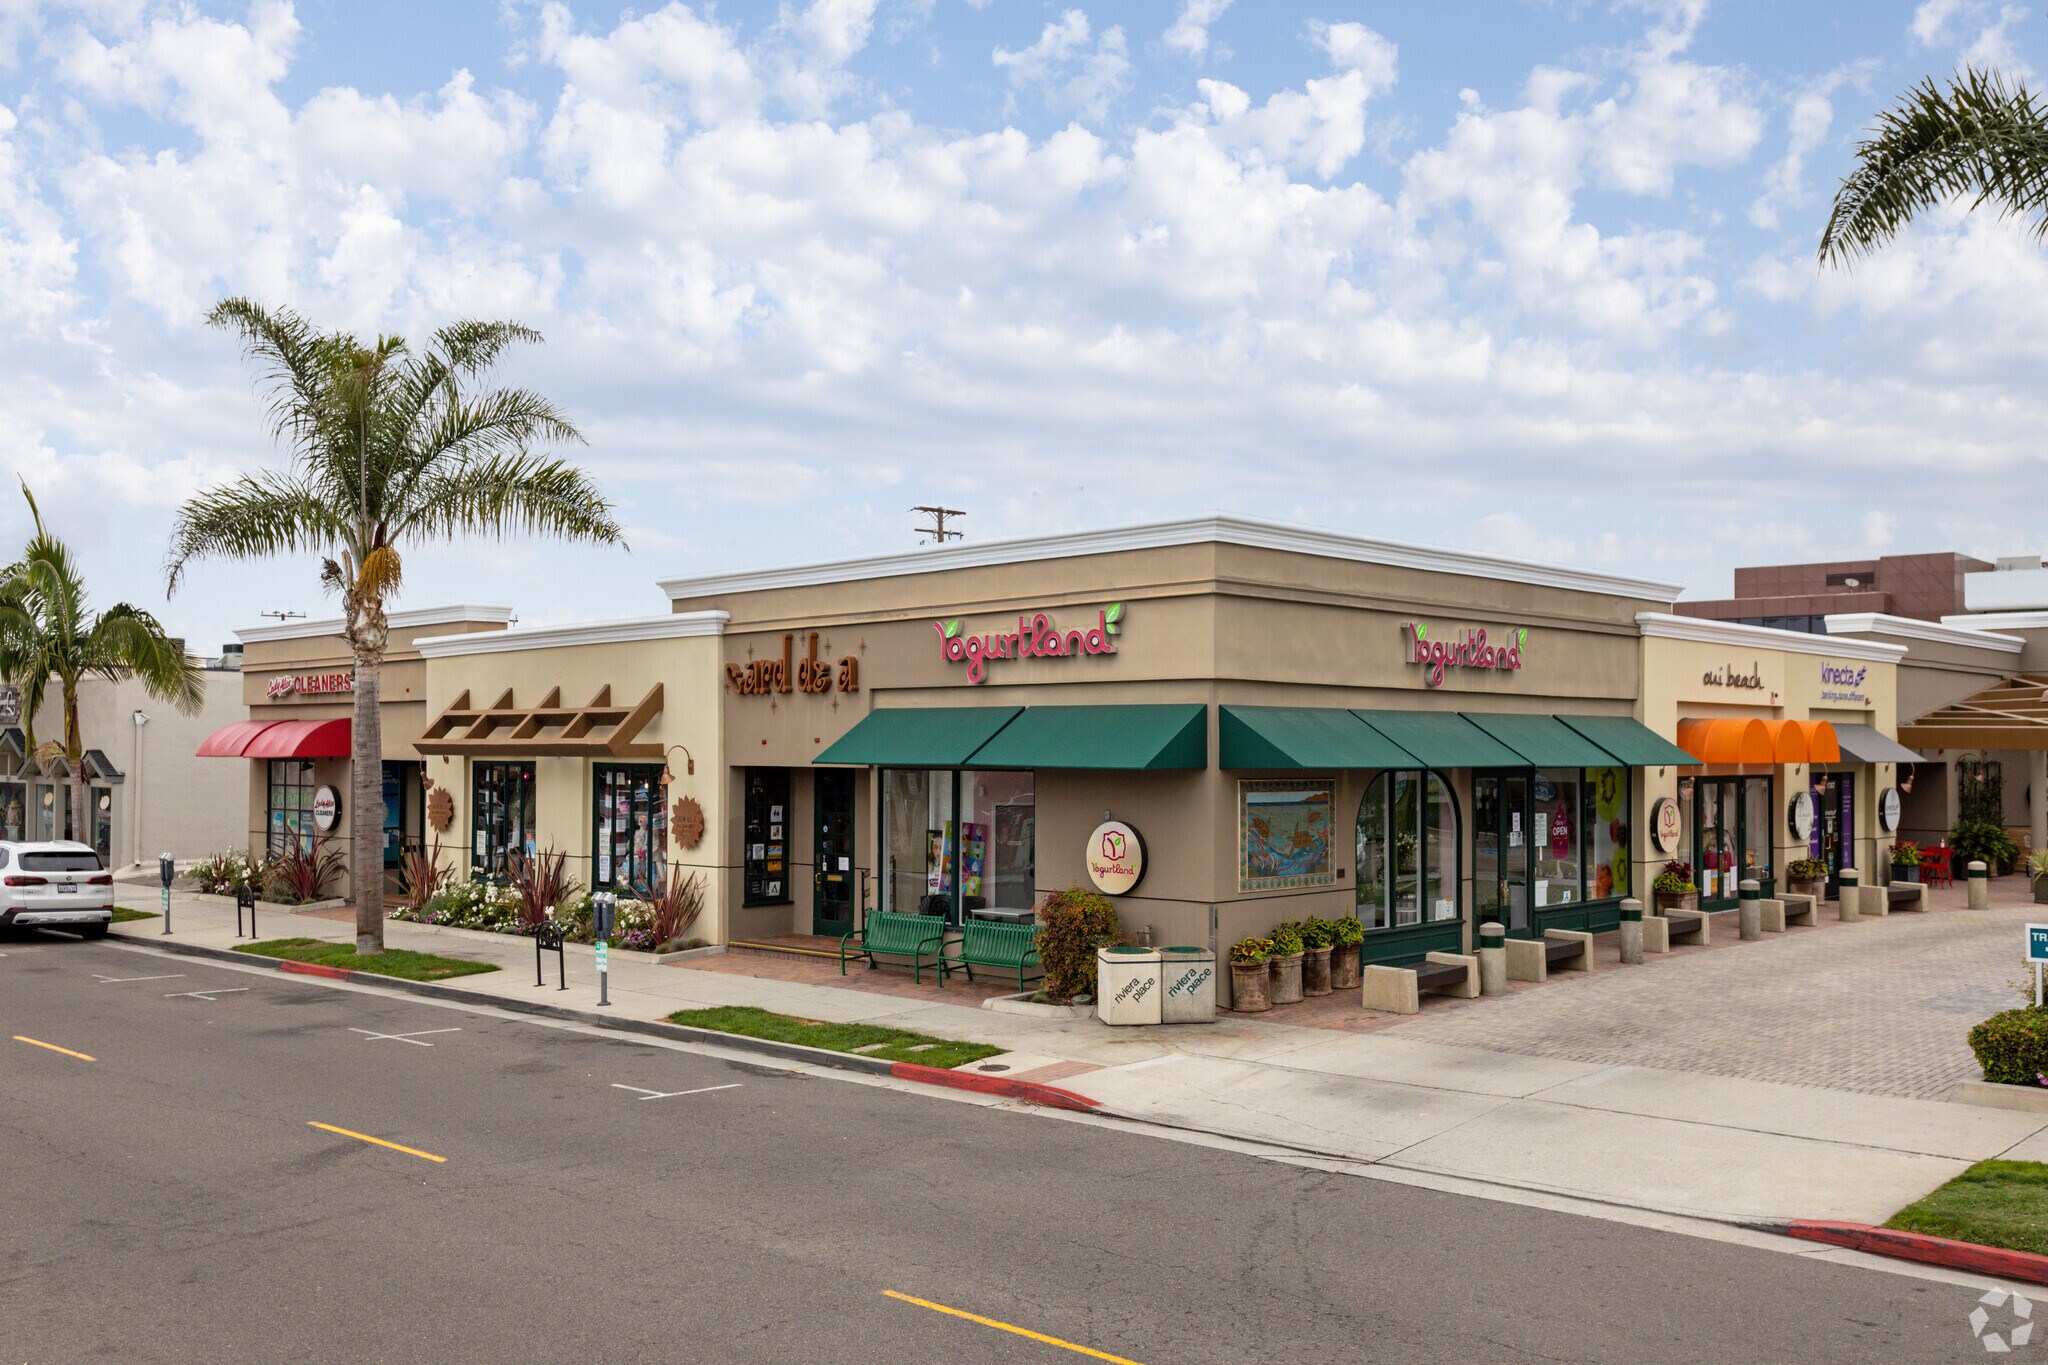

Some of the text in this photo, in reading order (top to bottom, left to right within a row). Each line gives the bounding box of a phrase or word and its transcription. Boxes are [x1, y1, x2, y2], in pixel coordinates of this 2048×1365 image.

[933, 602, 1121, 684] Yogurtland
[1408, 622, 1526, 687] Yogurtland
[725, 632, 793, 695] card
[1703, 661, 1764, 689] oui beach
[1821, 661, 1854, 686] kinecta
[294, 673, 351, 693] CLEANERS
[1553, 826, 1568, 836] OPEN
[1091, 862, 1137, 878] Yogurtland
[1115, 978, 1140, 1004] riviera
[1132, 977, 1155, 1003] place
[1168, 968, 1197, 998] riviera
[1186, 968, 1212, 995] place
